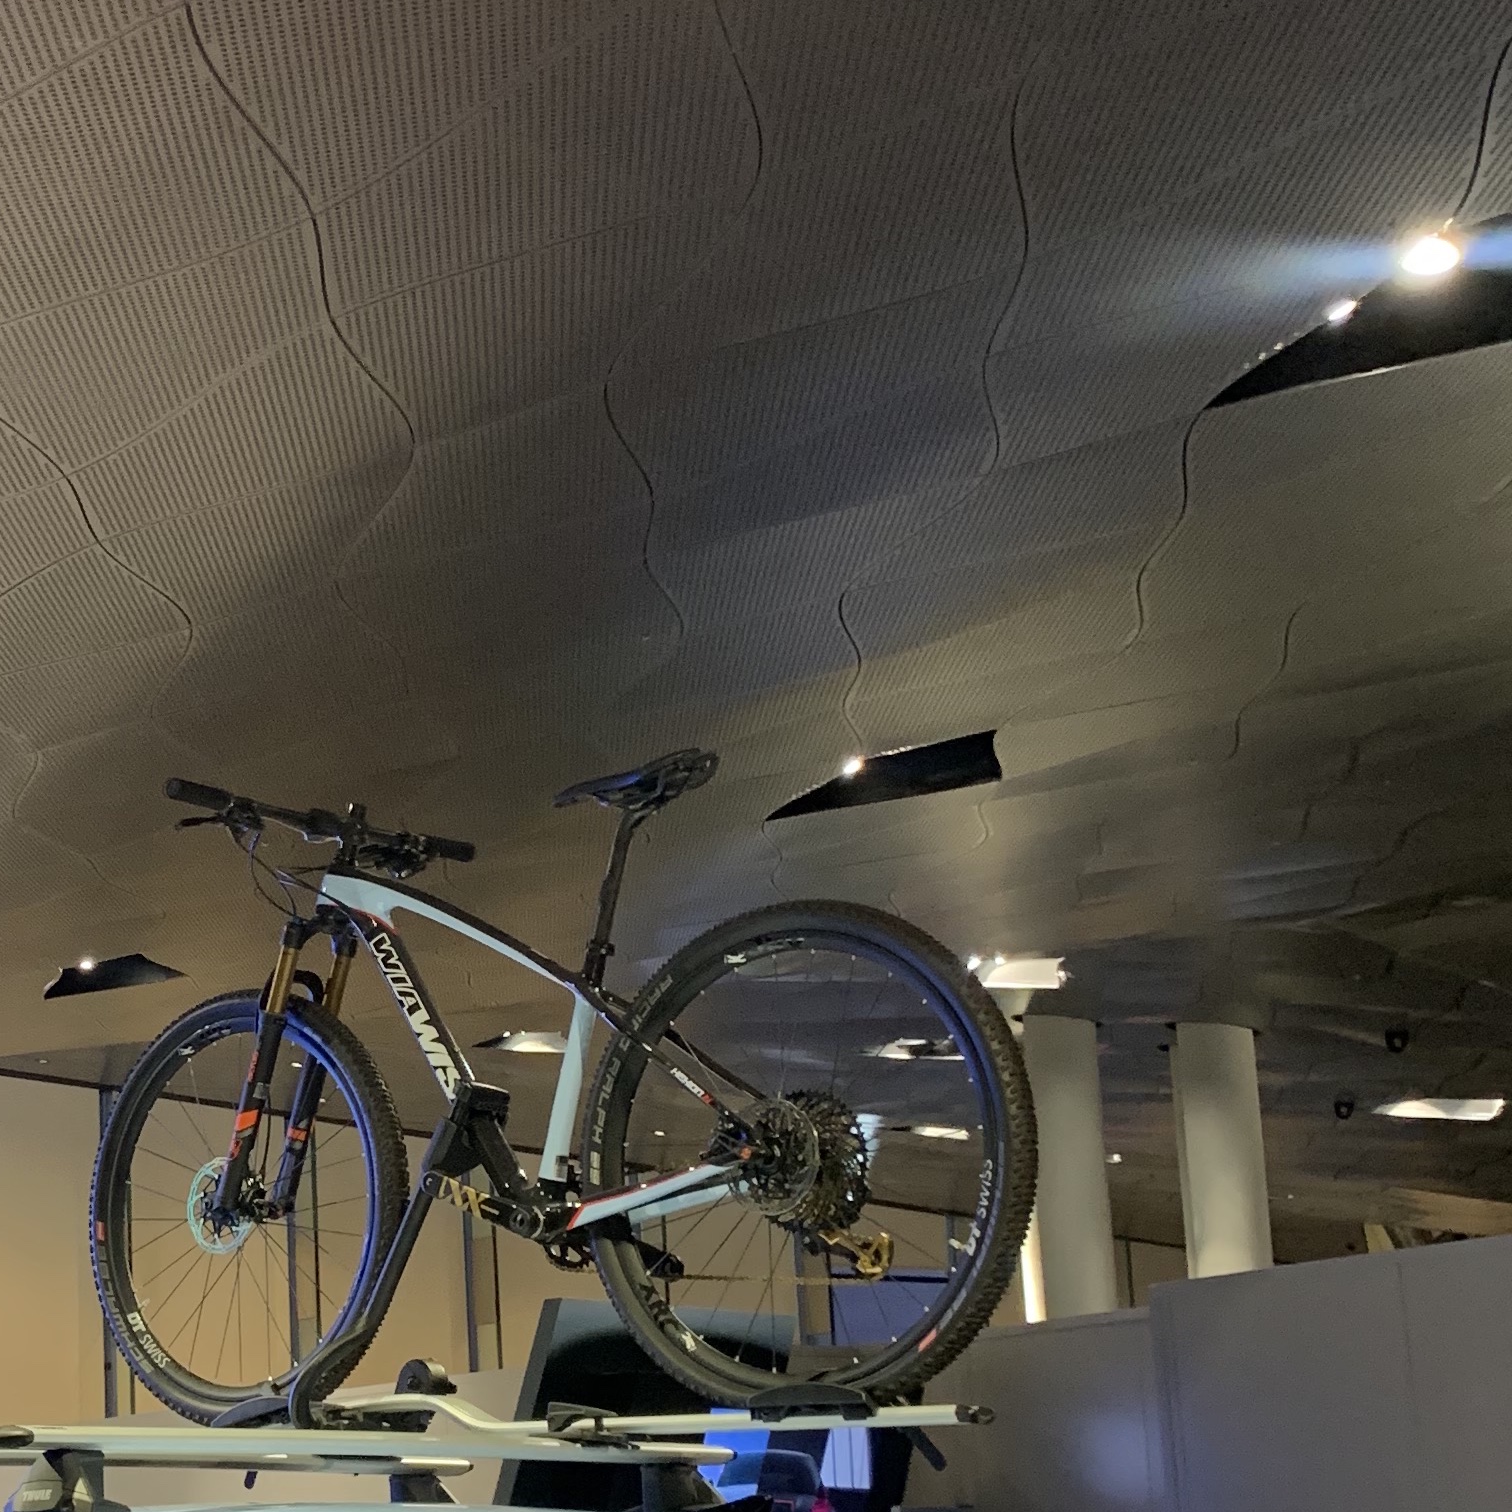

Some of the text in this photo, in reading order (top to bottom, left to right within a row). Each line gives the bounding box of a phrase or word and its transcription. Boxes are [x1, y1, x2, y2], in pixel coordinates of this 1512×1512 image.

[369, 932, 461, 1101] WIAWIS
[126, 1311, 171, 1369] DT SWISS
[22, 1488, 53, 1502] THULE
